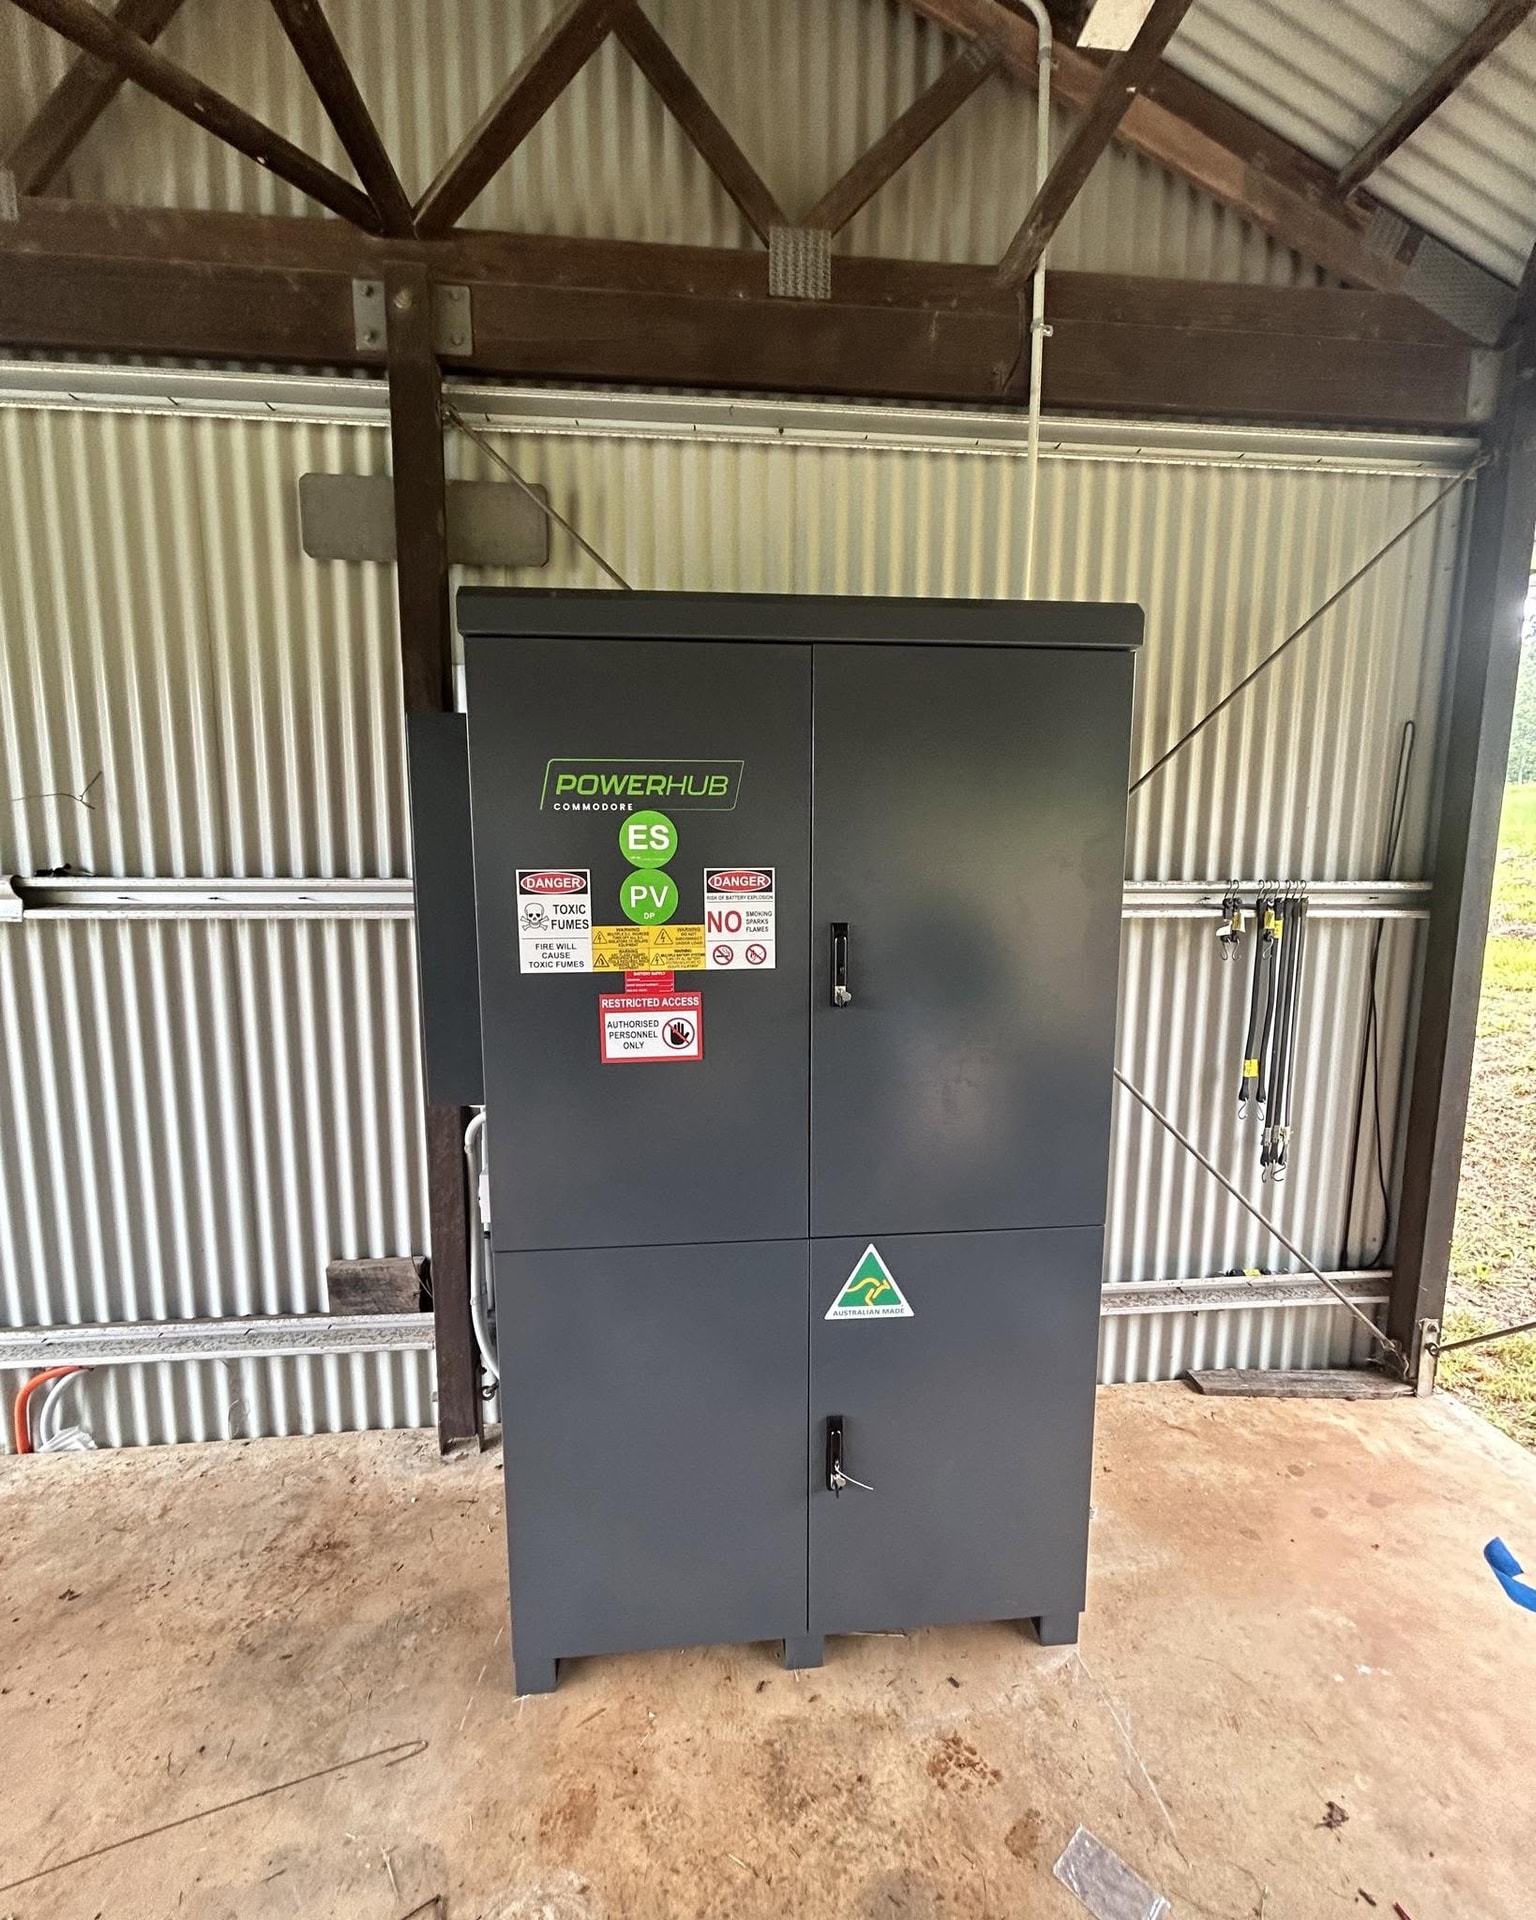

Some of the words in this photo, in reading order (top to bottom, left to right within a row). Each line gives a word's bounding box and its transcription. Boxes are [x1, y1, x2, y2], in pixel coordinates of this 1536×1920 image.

[555, 774, 729, 796] POWERHUB
[553, 803, 633, 811] COMMODORE
[628, 824, 670, 850] ES
[526, 877, 581, 888] DANGER
[713, 876, 766, 887] DANGER
[630, 885, 669, 908] PV
[552, 904, 586, 915] TOXIC
[643, 912, 655, 920] DP
[707, 910, 742, 933] NO
[551, 919, 589, 930] FUMES
[601, 998, 660, 1008] RESTRICTED
[661, 996, 699, 1006] ACCESS
[607, 1020, 660, 1029] AUTHORISED
[608, 1031, 658, 1039] PERSONNEL
[623, 1042, 645, 1050] ONLY
